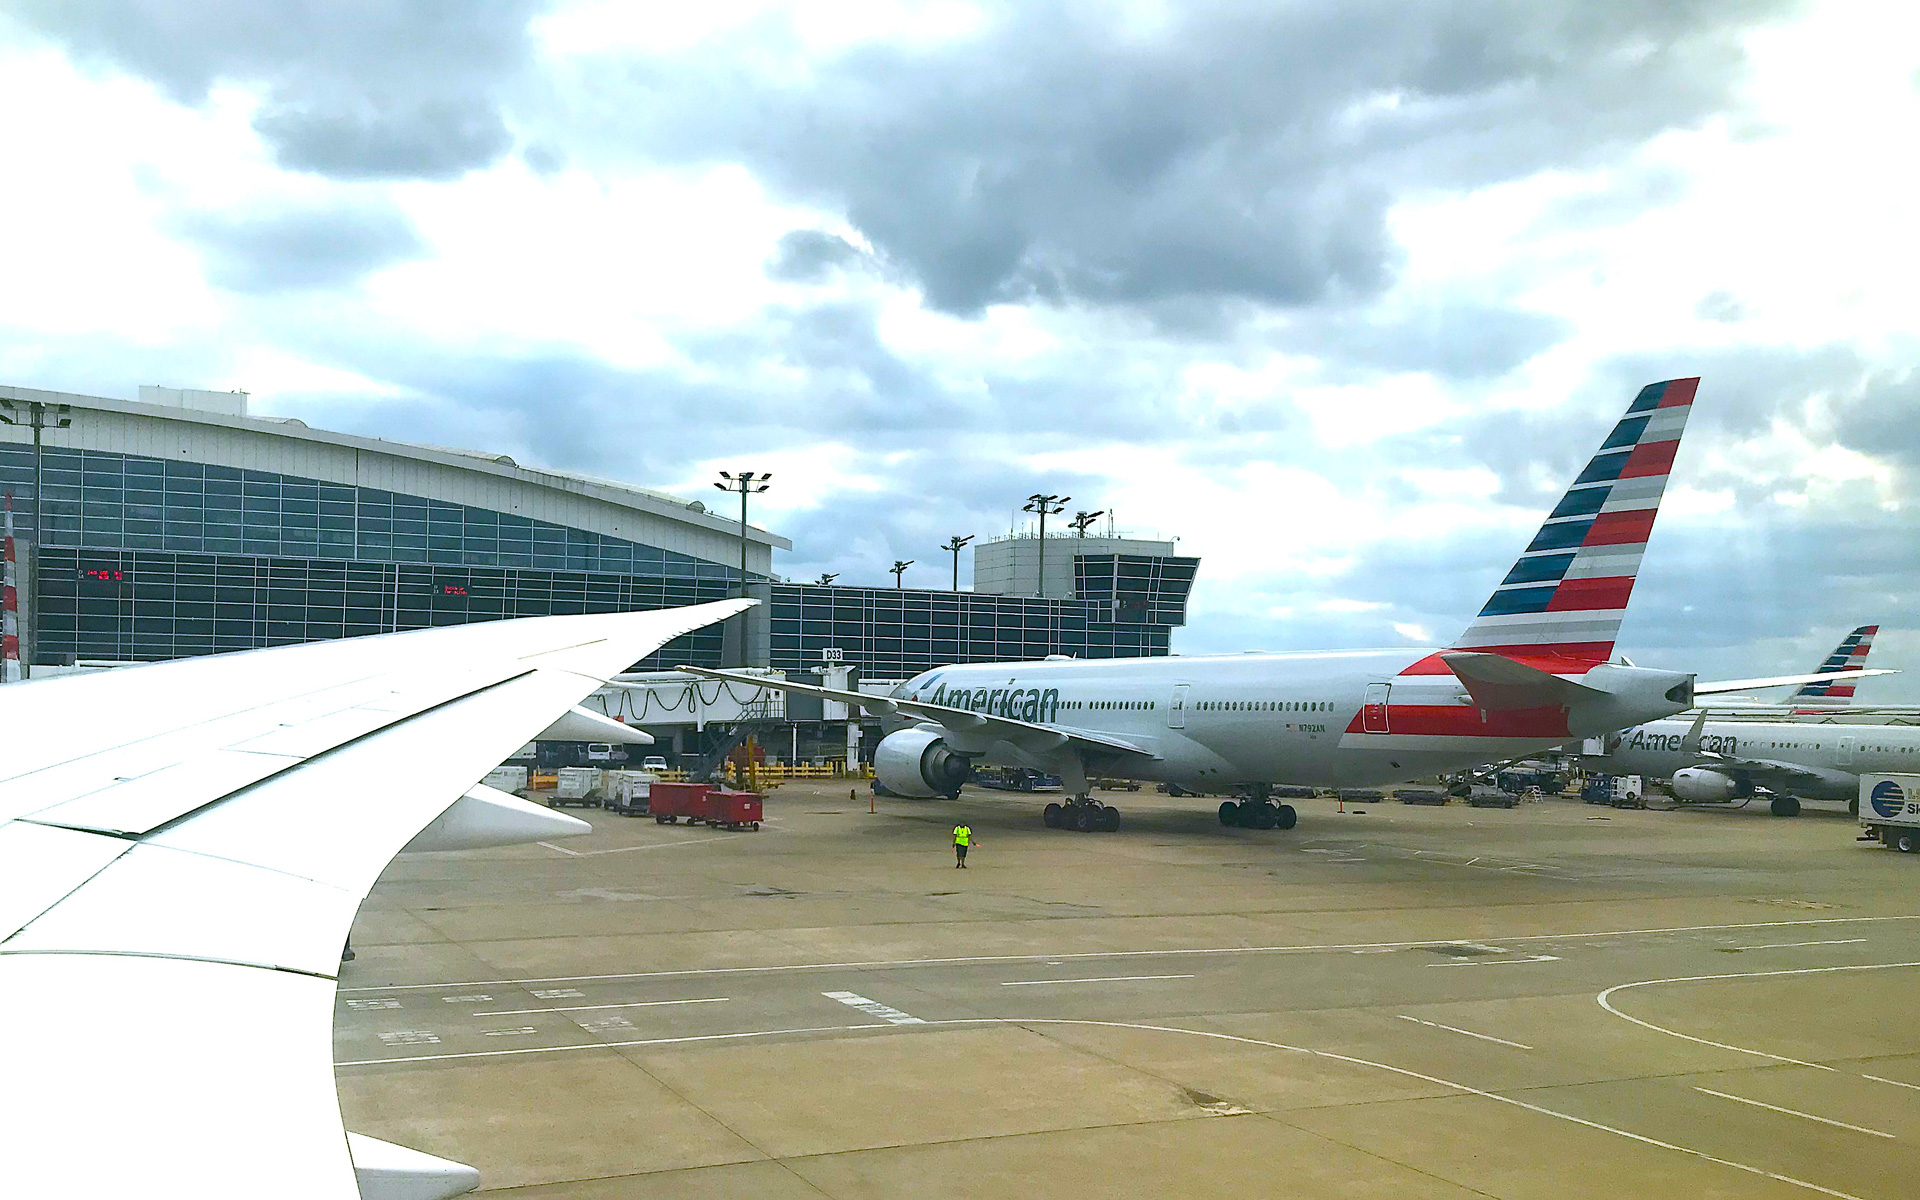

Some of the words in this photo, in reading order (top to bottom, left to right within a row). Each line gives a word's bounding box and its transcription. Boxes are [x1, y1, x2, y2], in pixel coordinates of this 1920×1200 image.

[826, 650, 841, 660] D33
[930, 678, 1059, 723] American
[1298, 724, 1325, 733] N792AN
[1629, 729, 1738, 754] Amecan
